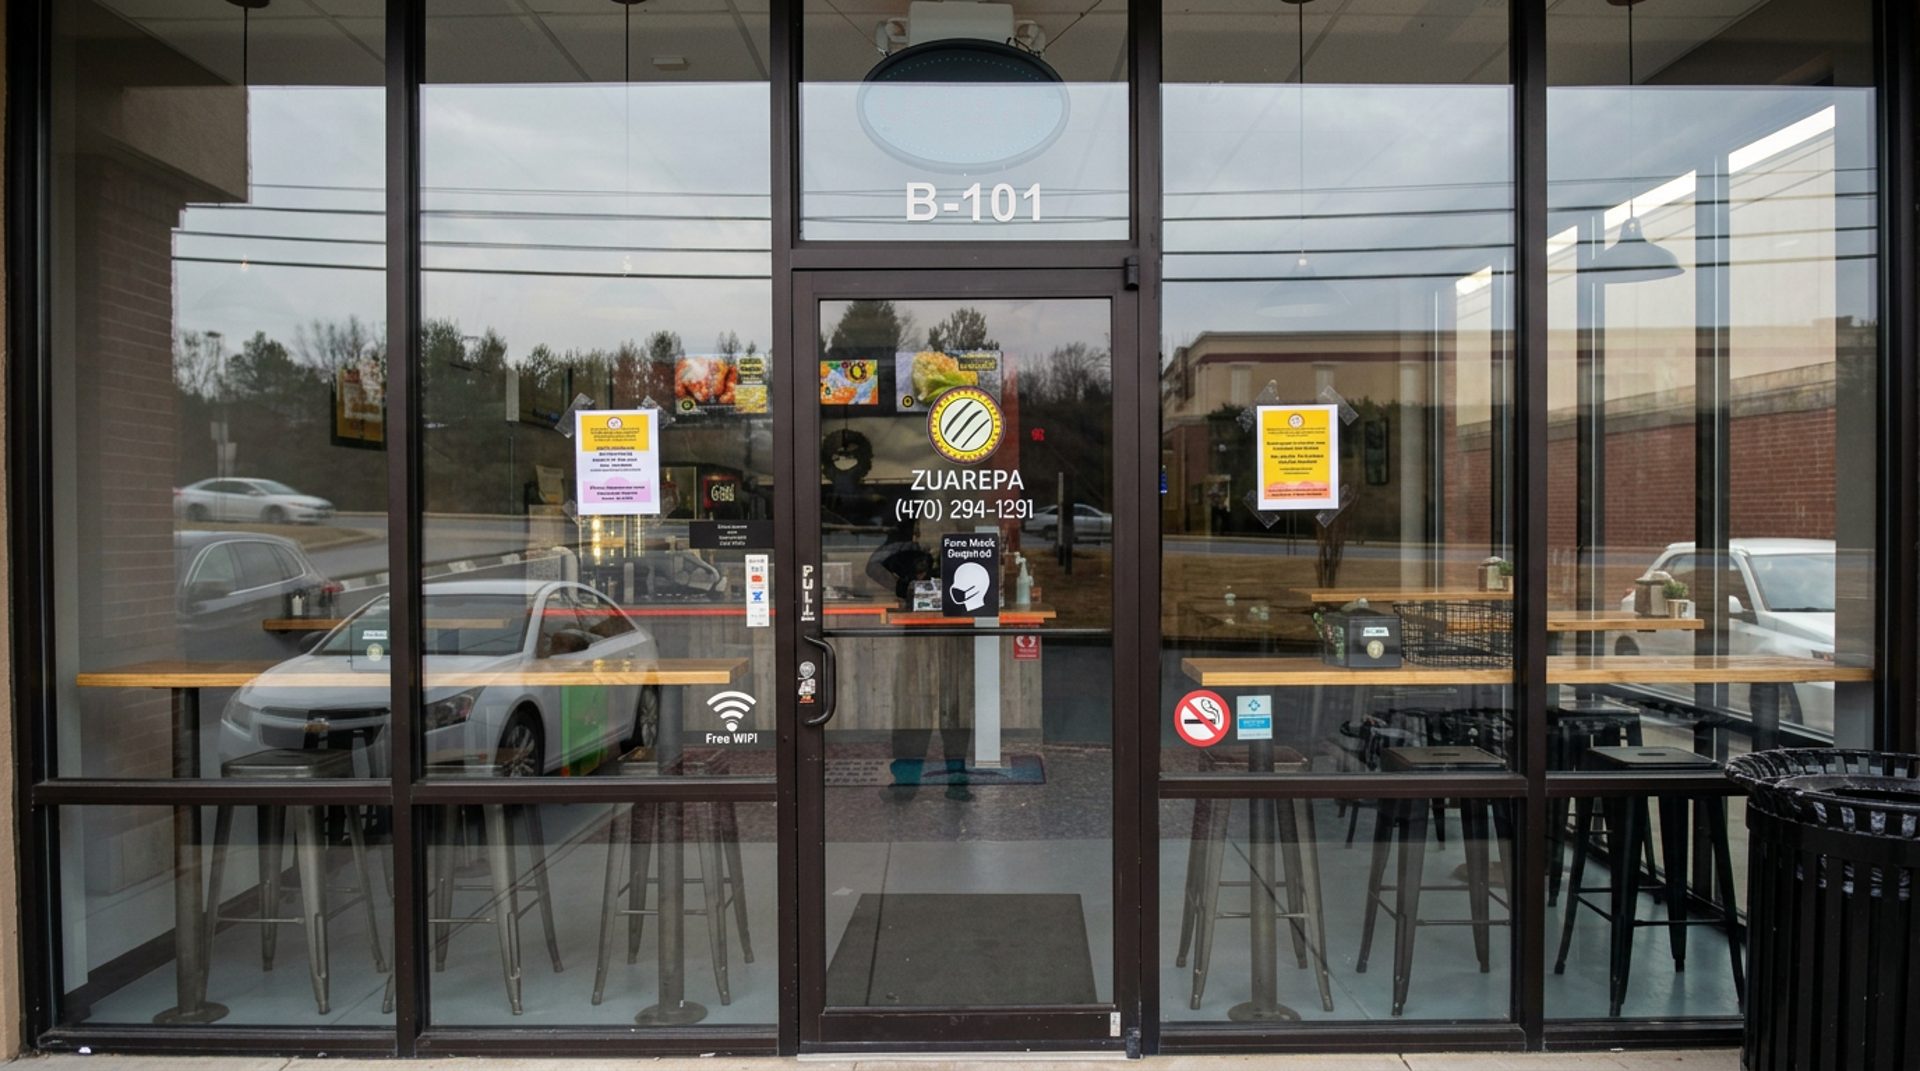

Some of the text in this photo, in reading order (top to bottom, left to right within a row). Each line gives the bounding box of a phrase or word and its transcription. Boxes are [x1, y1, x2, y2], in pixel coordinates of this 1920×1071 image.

[906, 182, 1040, 222] B-101
[911, 469, 1025, 490] ZUAREPA
[895, 498, 1034, 522] (470) 294-1291
[705, 733, 730, 744] Free
